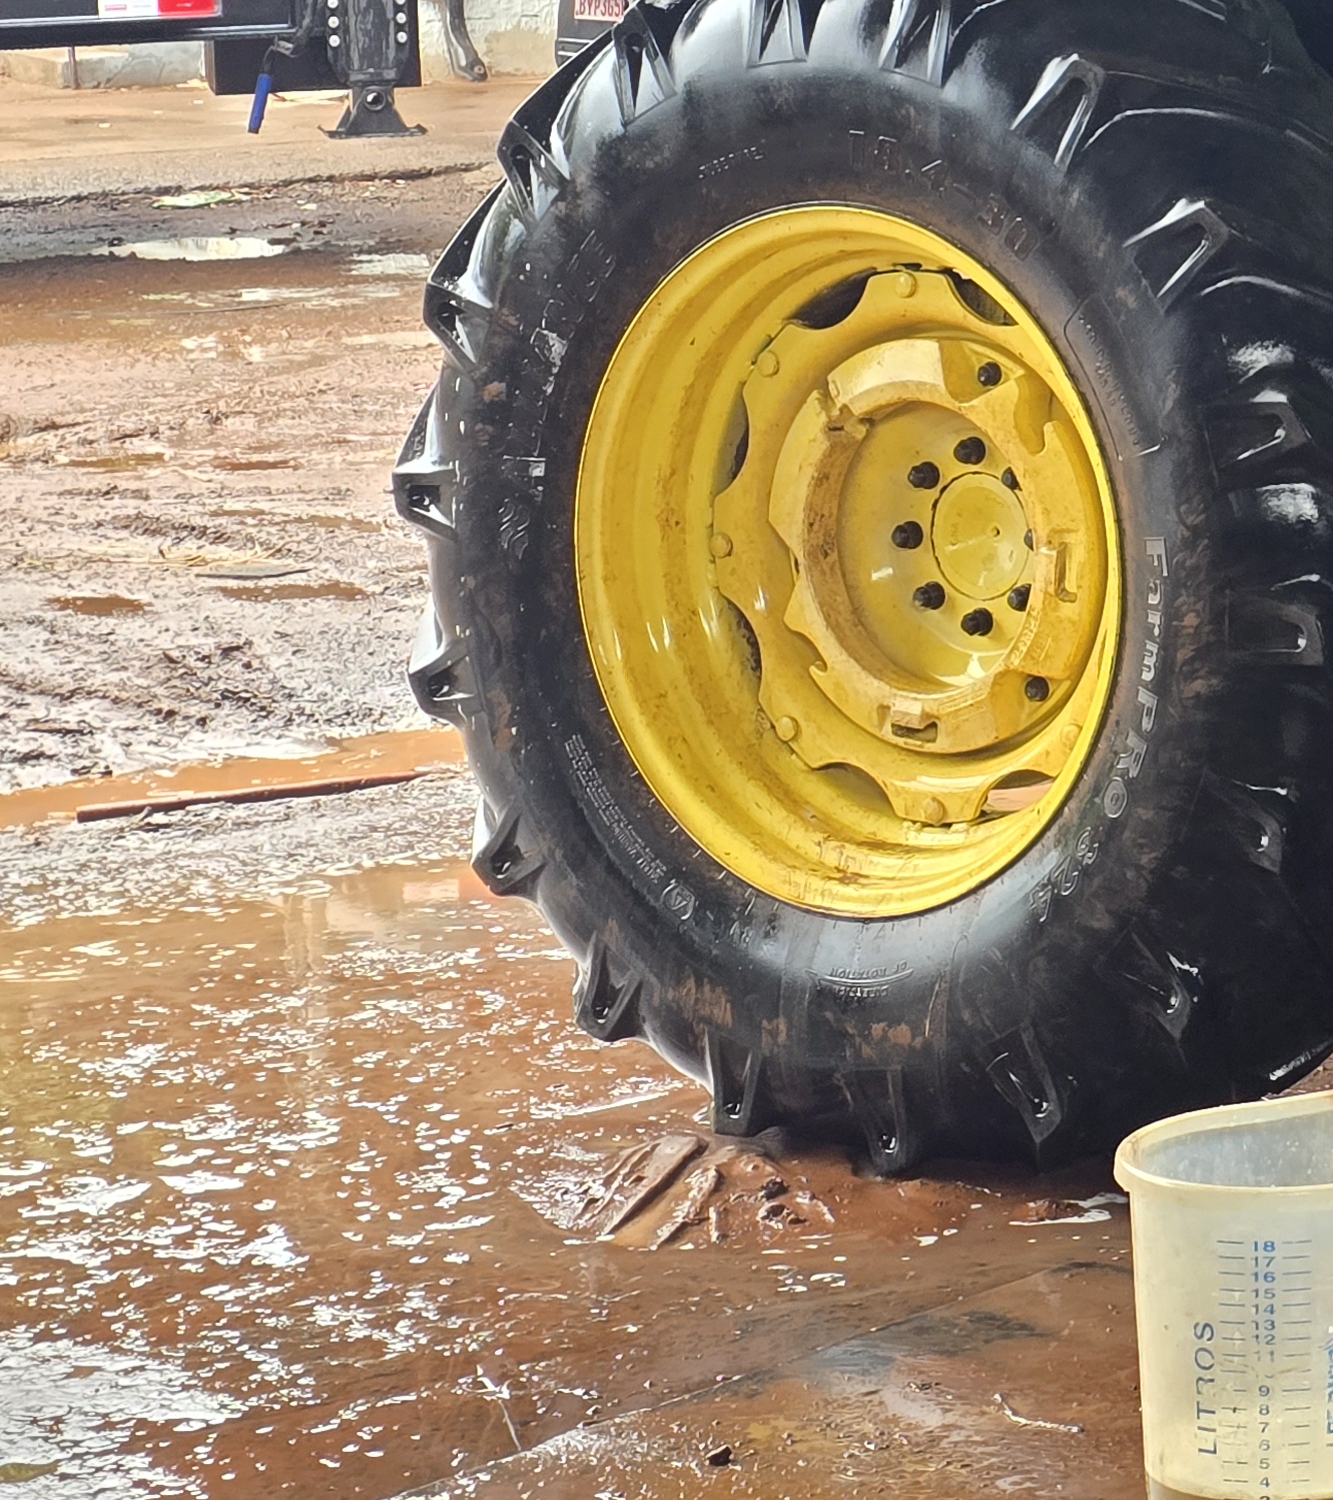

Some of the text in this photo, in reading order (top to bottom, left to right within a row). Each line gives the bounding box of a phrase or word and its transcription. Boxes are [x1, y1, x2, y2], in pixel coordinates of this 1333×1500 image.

[1253, 1240, 1275, 1252] 18
[1250, 1256, 1276, 1268] 17
[1251, 1271, 1276, 1283] 16
[1251, 1287, 1276, 1299] 15
[1251, 1303, 1276, 1315] 14
[1251, 1319, 1276, 1331] 13
[1193, 1322, 1218, 1455] LITROS
[1258, 1385, 1270, 1397] 9
[1258, 1404, 1270, 1416] 8
[1258, 1422, 1270, 1434] 7
[1258, 1439, 1271, 1451] 6
[1259, 1457, 1271, 1470] 5
[1259, 1477, 1271, 1488] 4
